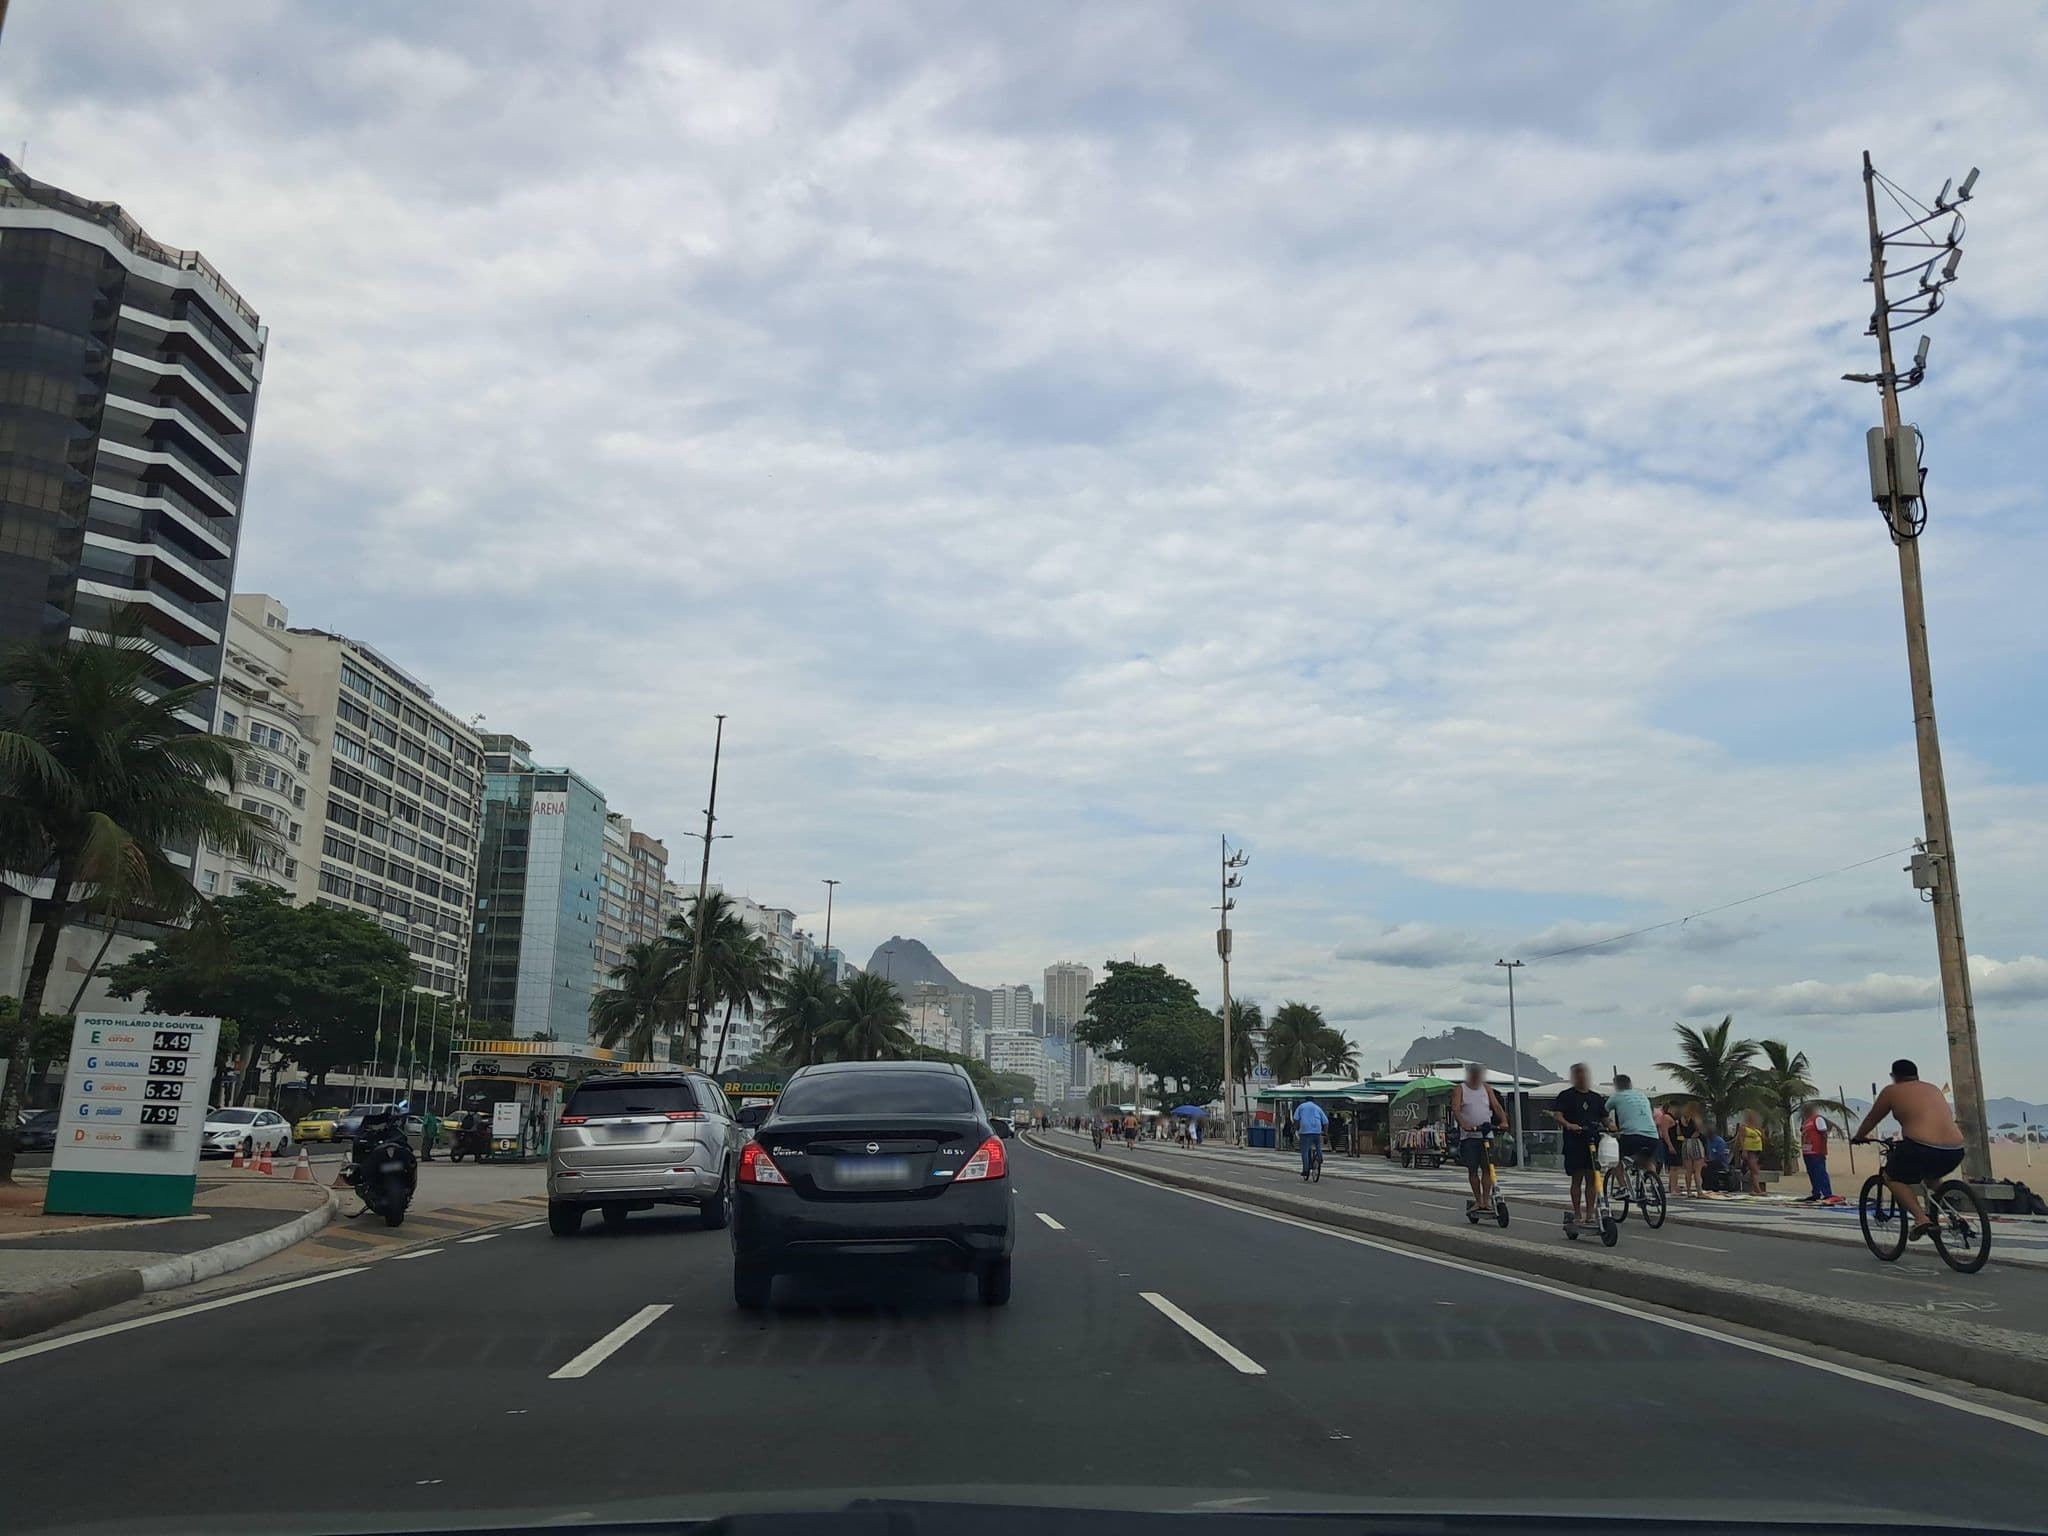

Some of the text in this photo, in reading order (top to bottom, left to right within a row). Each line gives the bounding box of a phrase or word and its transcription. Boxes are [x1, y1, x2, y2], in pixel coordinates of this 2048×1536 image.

[534, 800, 565, 816] ARENA
[84, 1018, 113, 1026] POSTO
[152, 1021, 165, 1029] DE
[165, 1022, 204, 1031] GOUVEIA
[91, 1031, 101, 1044] E
[87, 1057, 97, 1069] G
[83, 1080, 93, 1092] G
[79, 1104, 89, 1116] G
[74, 1129, 85, 1141] D
